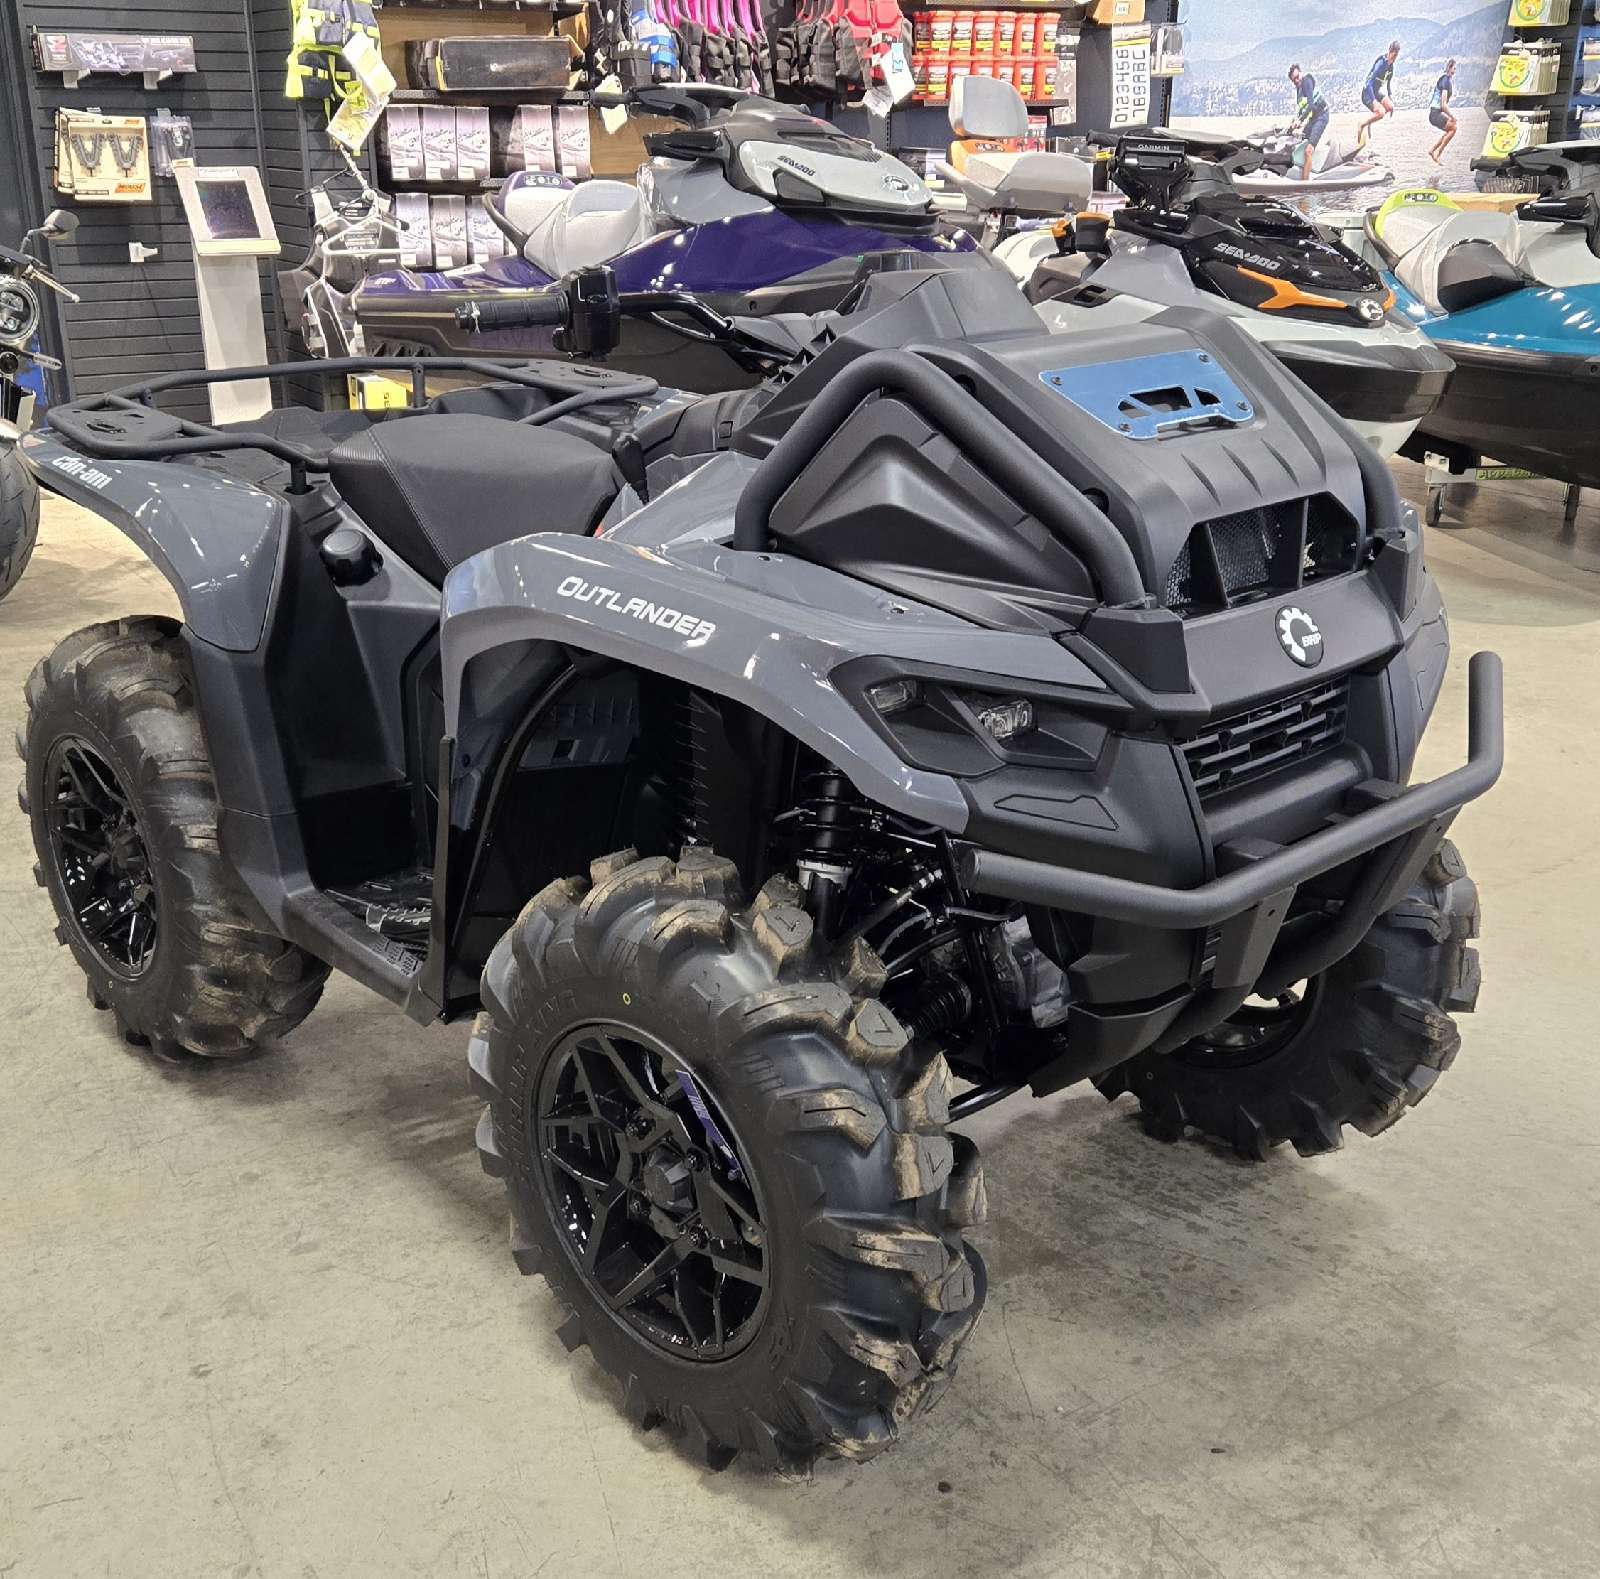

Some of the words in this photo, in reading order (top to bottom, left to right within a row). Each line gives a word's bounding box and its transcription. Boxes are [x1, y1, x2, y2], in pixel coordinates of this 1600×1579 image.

[52, 455, 113, 489] can-am
[557, 576, 717, 643] OUTLANDER
[1301, 632, 1322, 648] BRP
